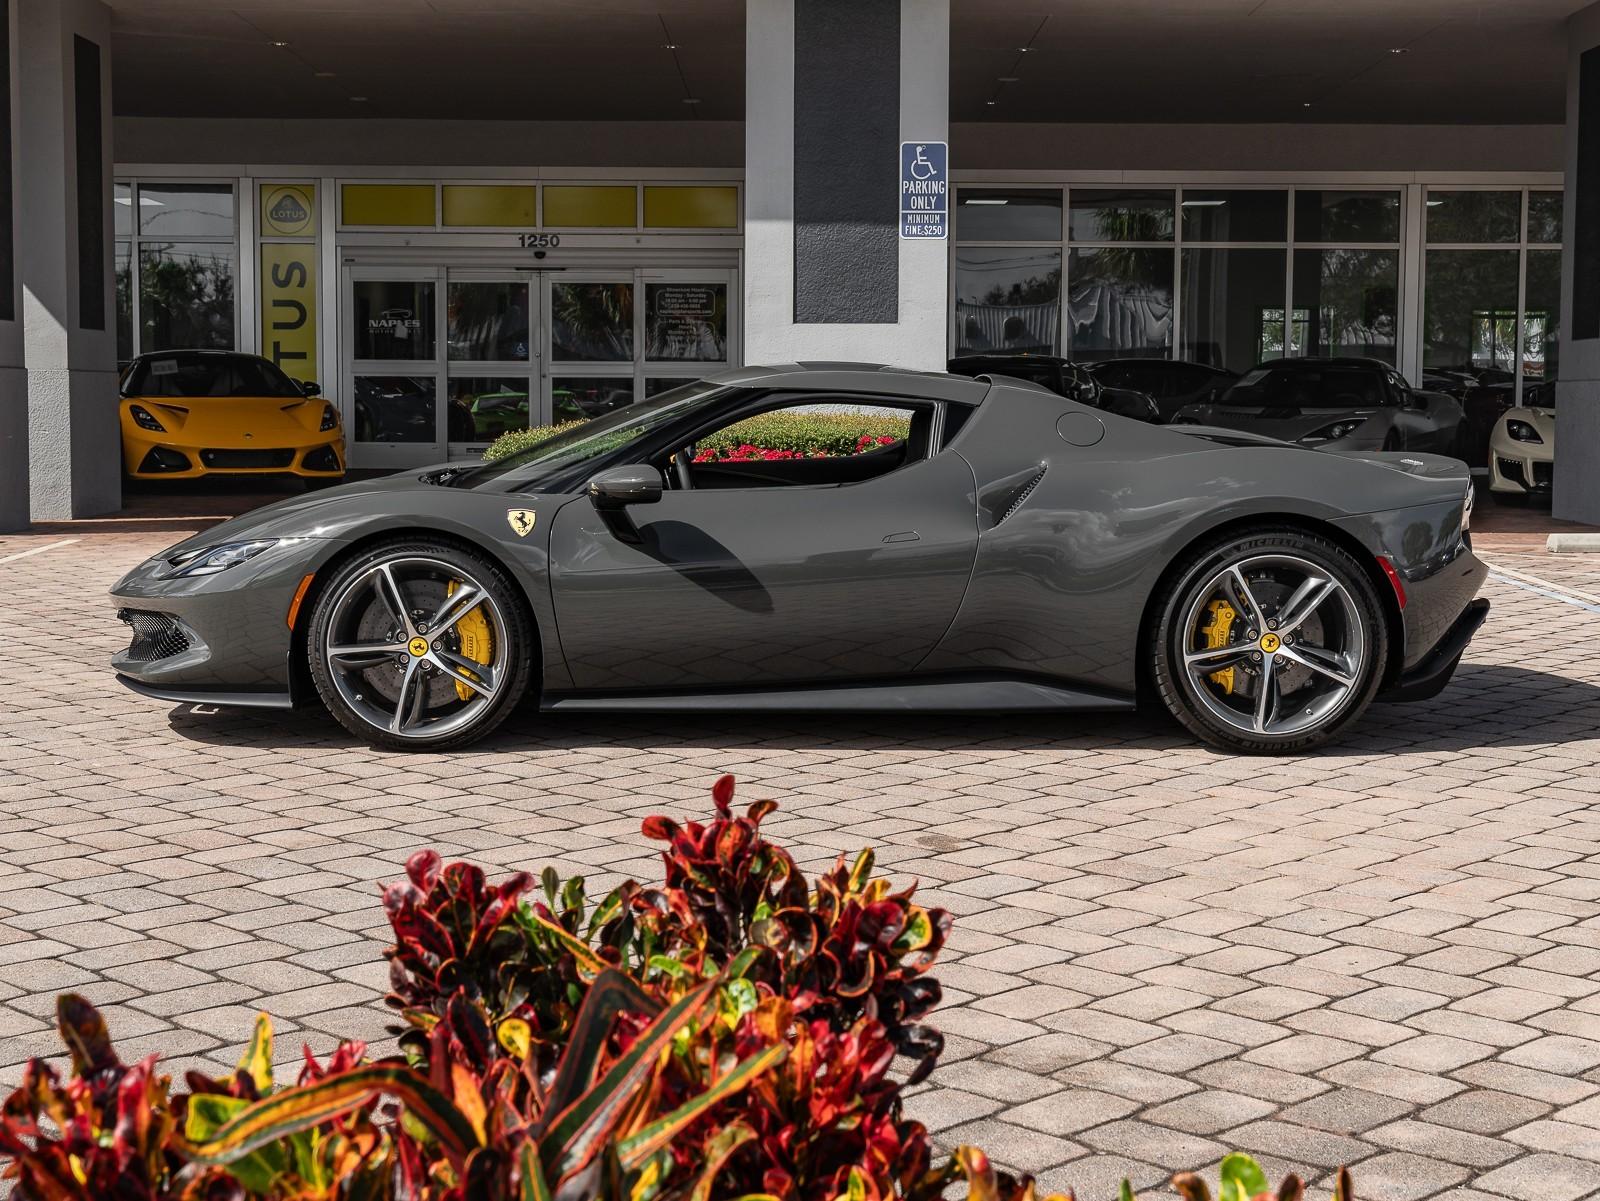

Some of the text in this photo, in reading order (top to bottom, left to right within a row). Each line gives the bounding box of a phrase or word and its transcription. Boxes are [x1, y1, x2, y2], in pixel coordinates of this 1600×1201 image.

[903, 181, 945, 194] PARKING
[910, 196, 937, 210] ONLY
[272, 210, 305, 219] LOTUS
[907, 214, 940, 224] MINIMUM
[905, 225, 942, 236] FINE $250
[518, 234, 560, 248] 1250
[272, 261, 307, 369] TUS
[1239, 537, 1304, 551] MICHELIN
